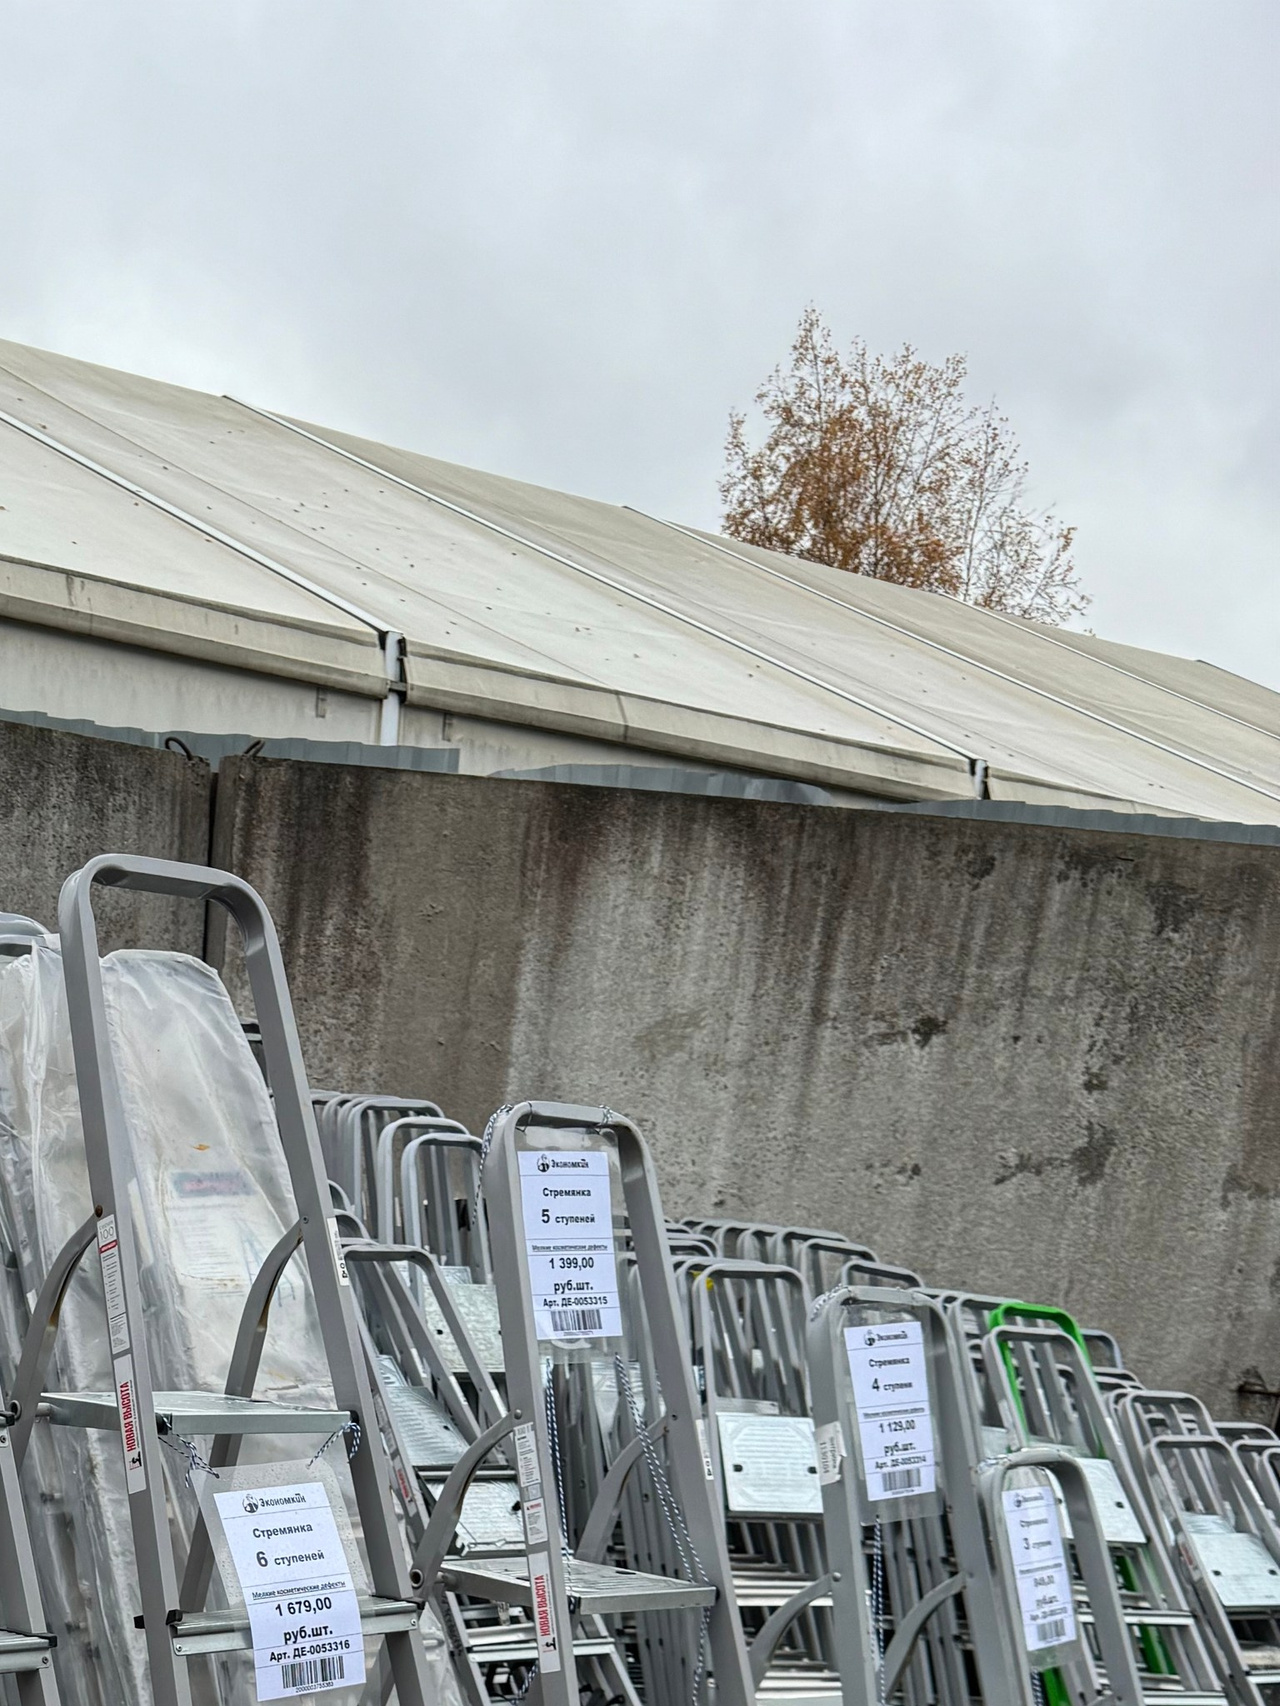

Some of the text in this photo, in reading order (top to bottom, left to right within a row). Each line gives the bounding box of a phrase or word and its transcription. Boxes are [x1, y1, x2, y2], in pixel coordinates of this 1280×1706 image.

[543, 1188, 591, 1198] Стремянка
[541, 1209, 595, 1225] 5 ступеней
[100, 1227, 114, 1239] 100
[549, 1257, 594, 1271] 1 399,00
[554, 1280, 594, 1294] руб.шт.
[543, 1298, 559, 1308] Арт.
[872, 1378, 880, 1391] 4
[120, 1381, 132, 1421] ВЫСОТА
[879, 1419, 916, 1433] 1 129,00
[124, 1423, 136, 1452] НОВАЯ
[253, 1524, 313, 1539] Стремянка
[256, 1550, 325, 1567] 6 ступеней
[534, 1575, 548, 1608] ВЫСОТА
[275, 1597, 332, 1616] 1 679,00
[537, 1610, 551, 1636] НОВАЯ
[283, 1626, 333, 1645] руб.шт.
[269, 1640, 350, 1662] Арт. ДЕ-0053316
